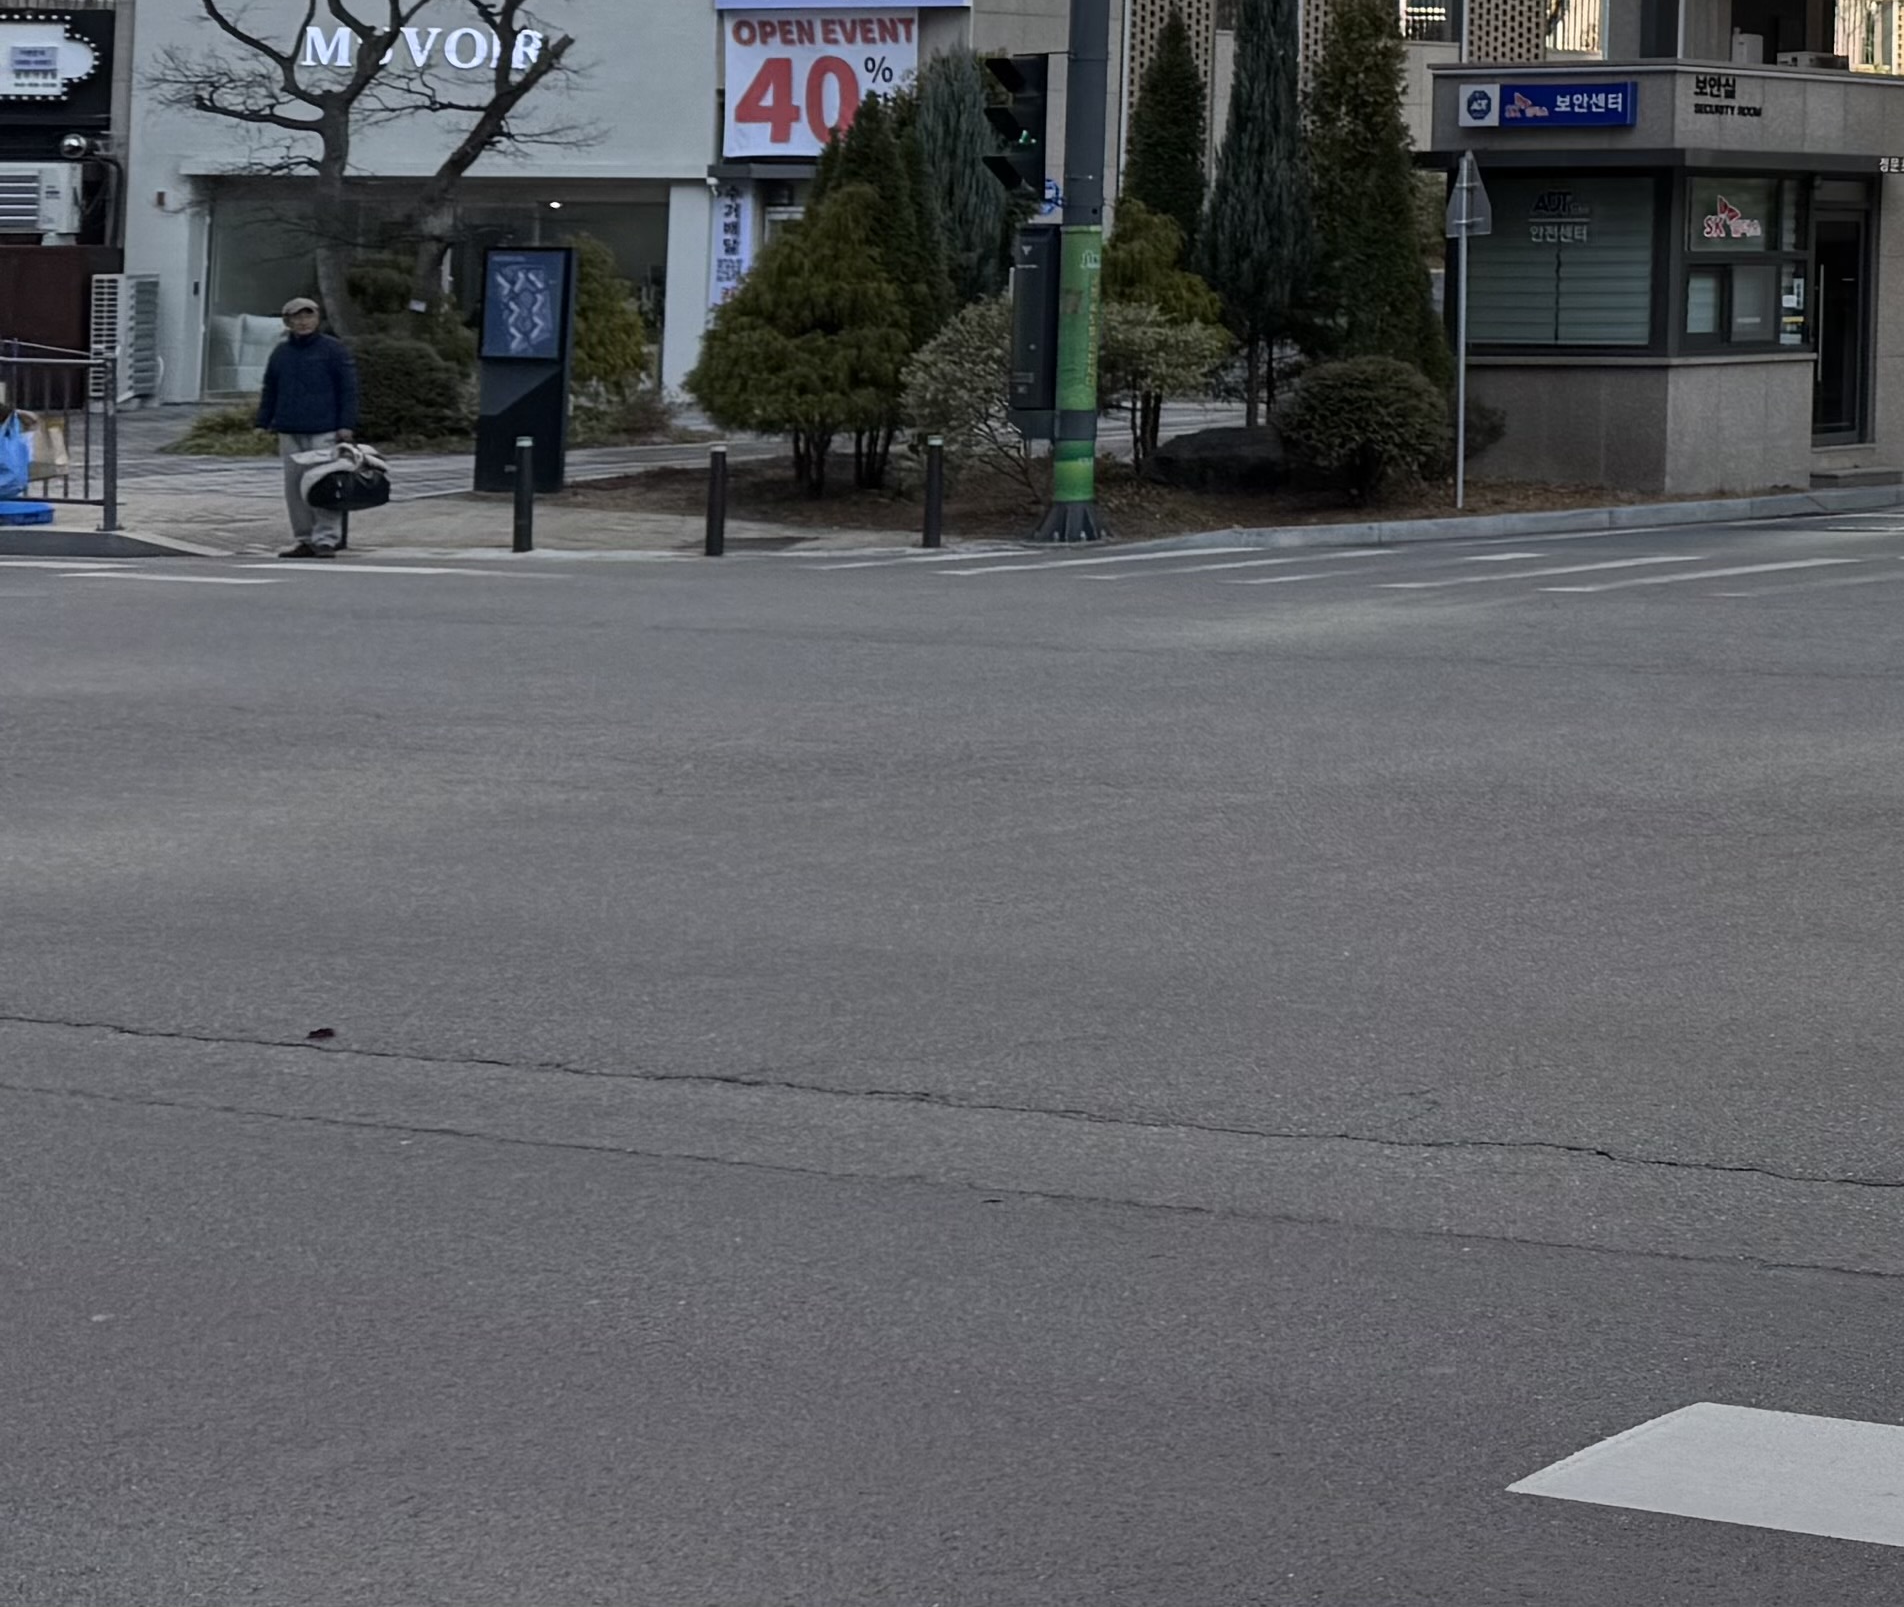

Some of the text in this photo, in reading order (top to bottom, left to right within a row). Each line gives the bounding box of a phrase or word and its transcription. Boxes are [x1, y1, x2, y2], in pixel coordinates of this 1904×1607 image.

[732, 17, 916, 47] OPEN EVENT
[1693, 75, 1737, 100] 보안실
[1553, 92, 1623, 113] 보안센터
[1694, 103, 1736, 116] SECURITY
[1532, 191, 1573, 213] ADT
[1529, 224, 1588, 244] 안전센터
[1704, 214, 1726, 238] SK
